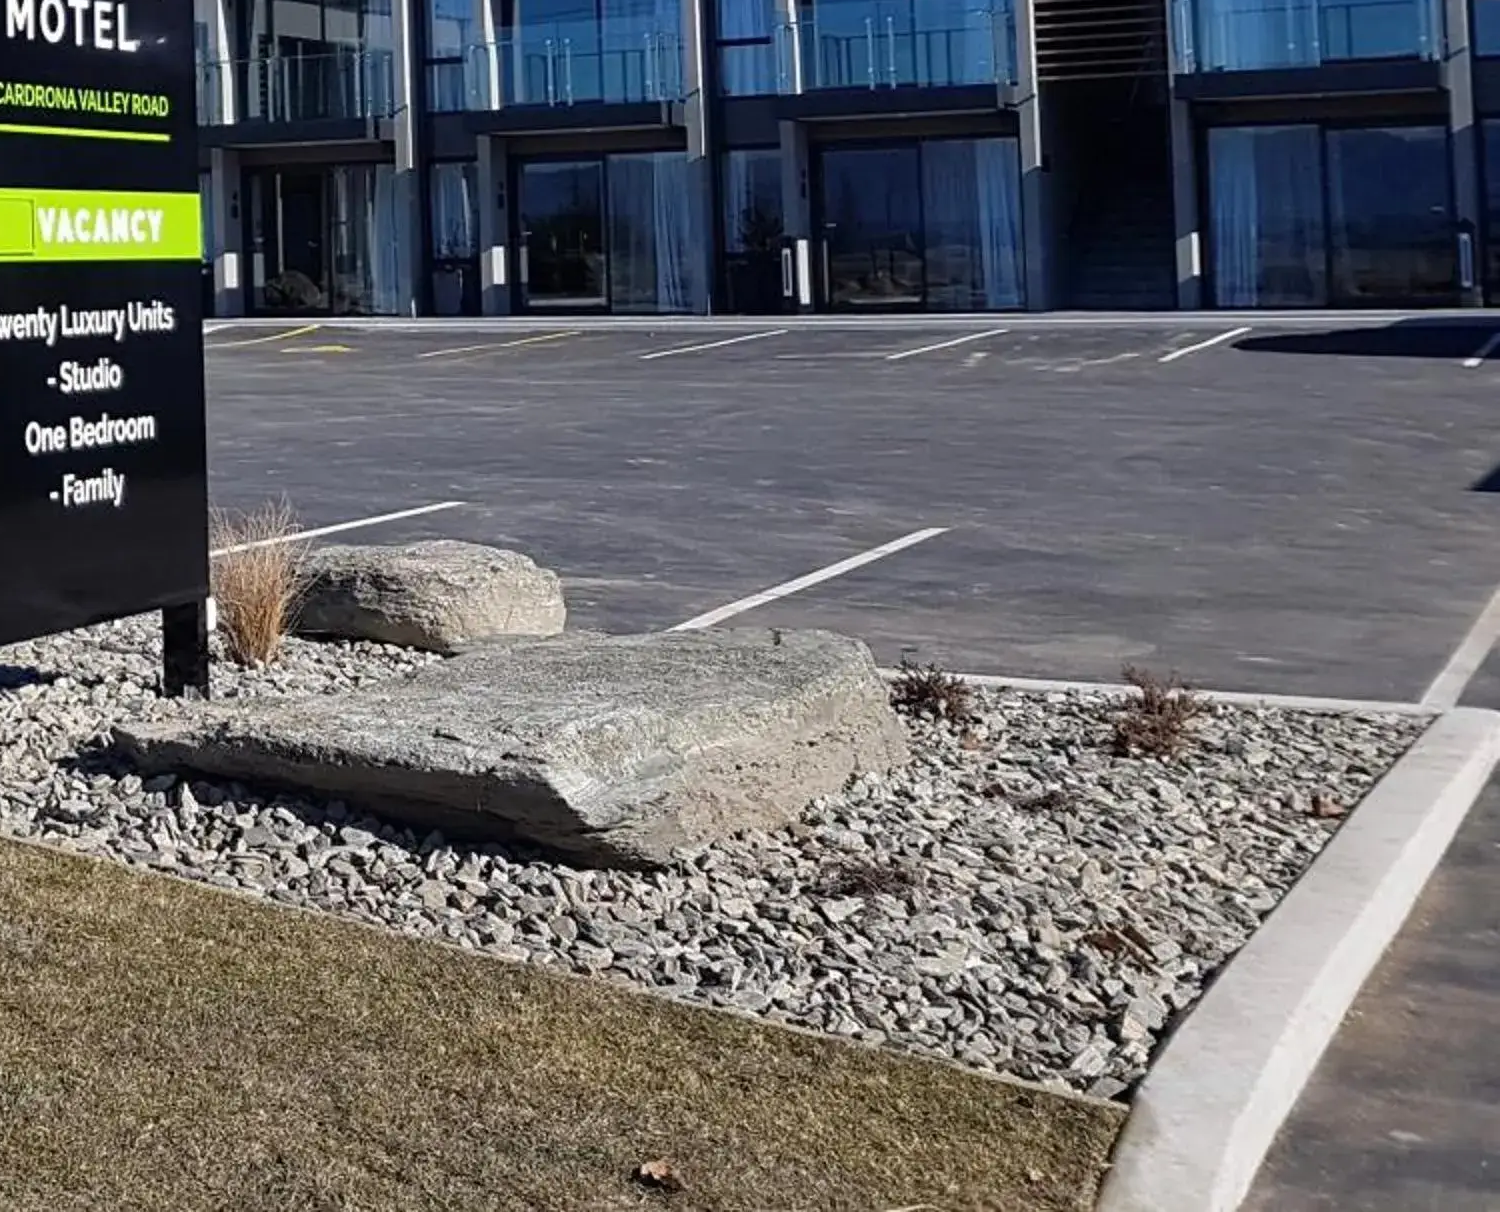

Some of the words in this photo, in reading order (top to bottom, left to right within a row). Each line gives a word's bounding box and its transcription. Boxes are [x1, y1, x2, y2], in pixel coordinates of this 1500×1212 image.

[78, 90, 130, 113] VALLEY
[132, 94, 168, 116] ROAD
[38, 208, 163, 243] VACANCY
[61, 305, 125, 340] Luxury
[128, 300, 174, 331] Units
[25, 422, 66, 453] One
[70, 413, 154, 447] Bedroom
